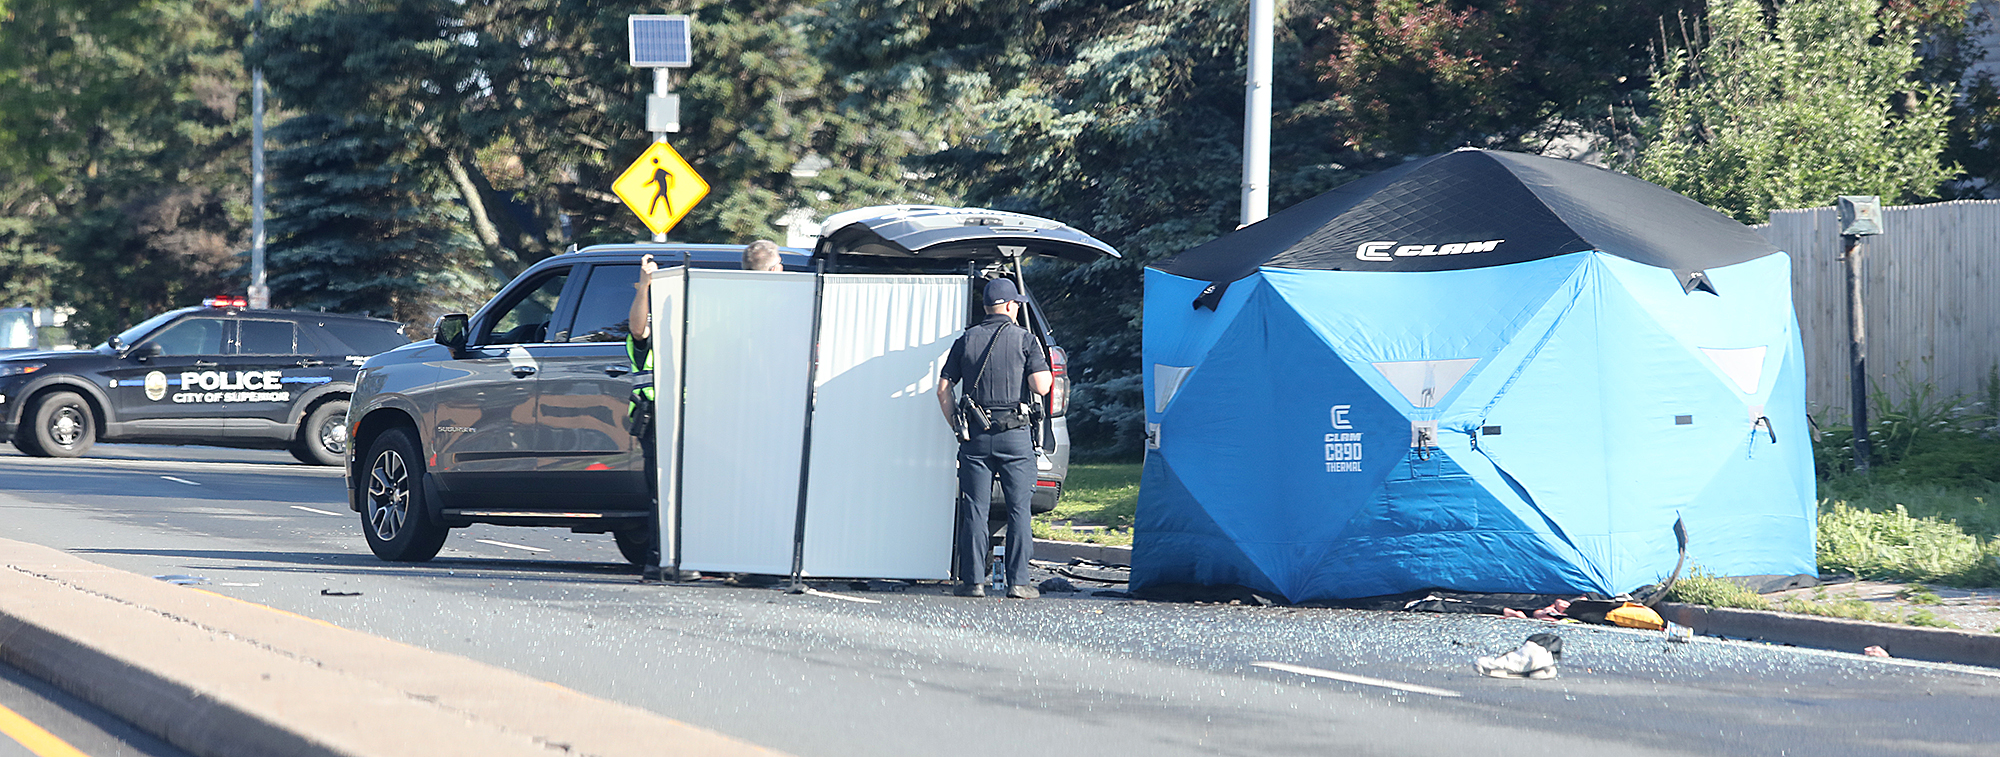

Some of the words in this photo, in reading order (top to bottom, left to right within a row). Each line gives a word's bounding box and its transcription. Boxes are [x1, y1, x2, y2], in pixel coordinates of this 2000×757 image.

[1394, 239, 1505, 257] CLAM
[181, 371, 282, 390] POLICE
[172, 393, 203, 403] CITY
[204, 392, 224, 402] OF
[224, 392, 290, 402] SUPERIOR
[1324, 433, 1362, 442] CLAM
[1325, 462, 1362, 472] THERMAL
